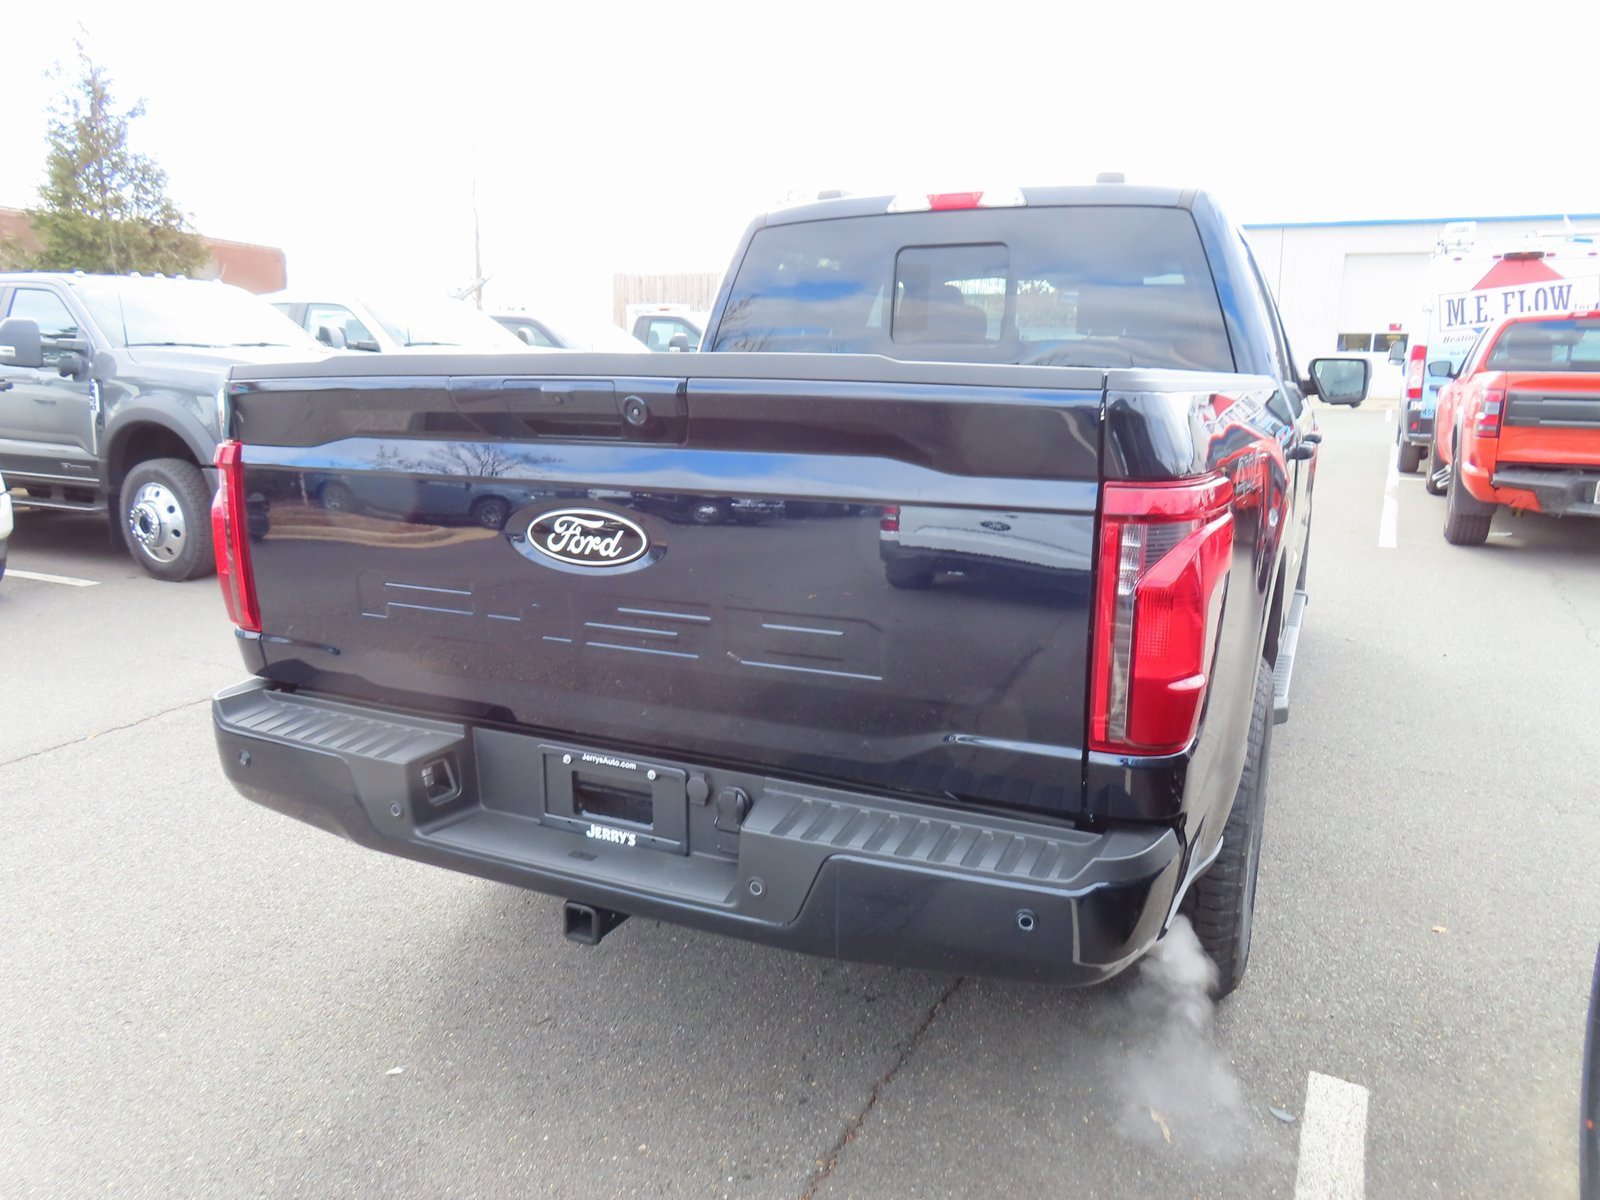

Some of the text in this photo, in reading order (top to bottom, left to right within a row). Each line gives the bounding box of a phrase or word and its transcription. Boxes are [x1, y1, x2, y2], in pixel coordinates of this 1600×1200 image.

[1447, 295, 1494, 327] M.E.
[1503, 285, 1572, 314] FLOW
[547, 516, 624, 557] Ford
[581, 753, 637, 770] JerrysAuto.com
[586, 824, 636, 847] JERRY'S
